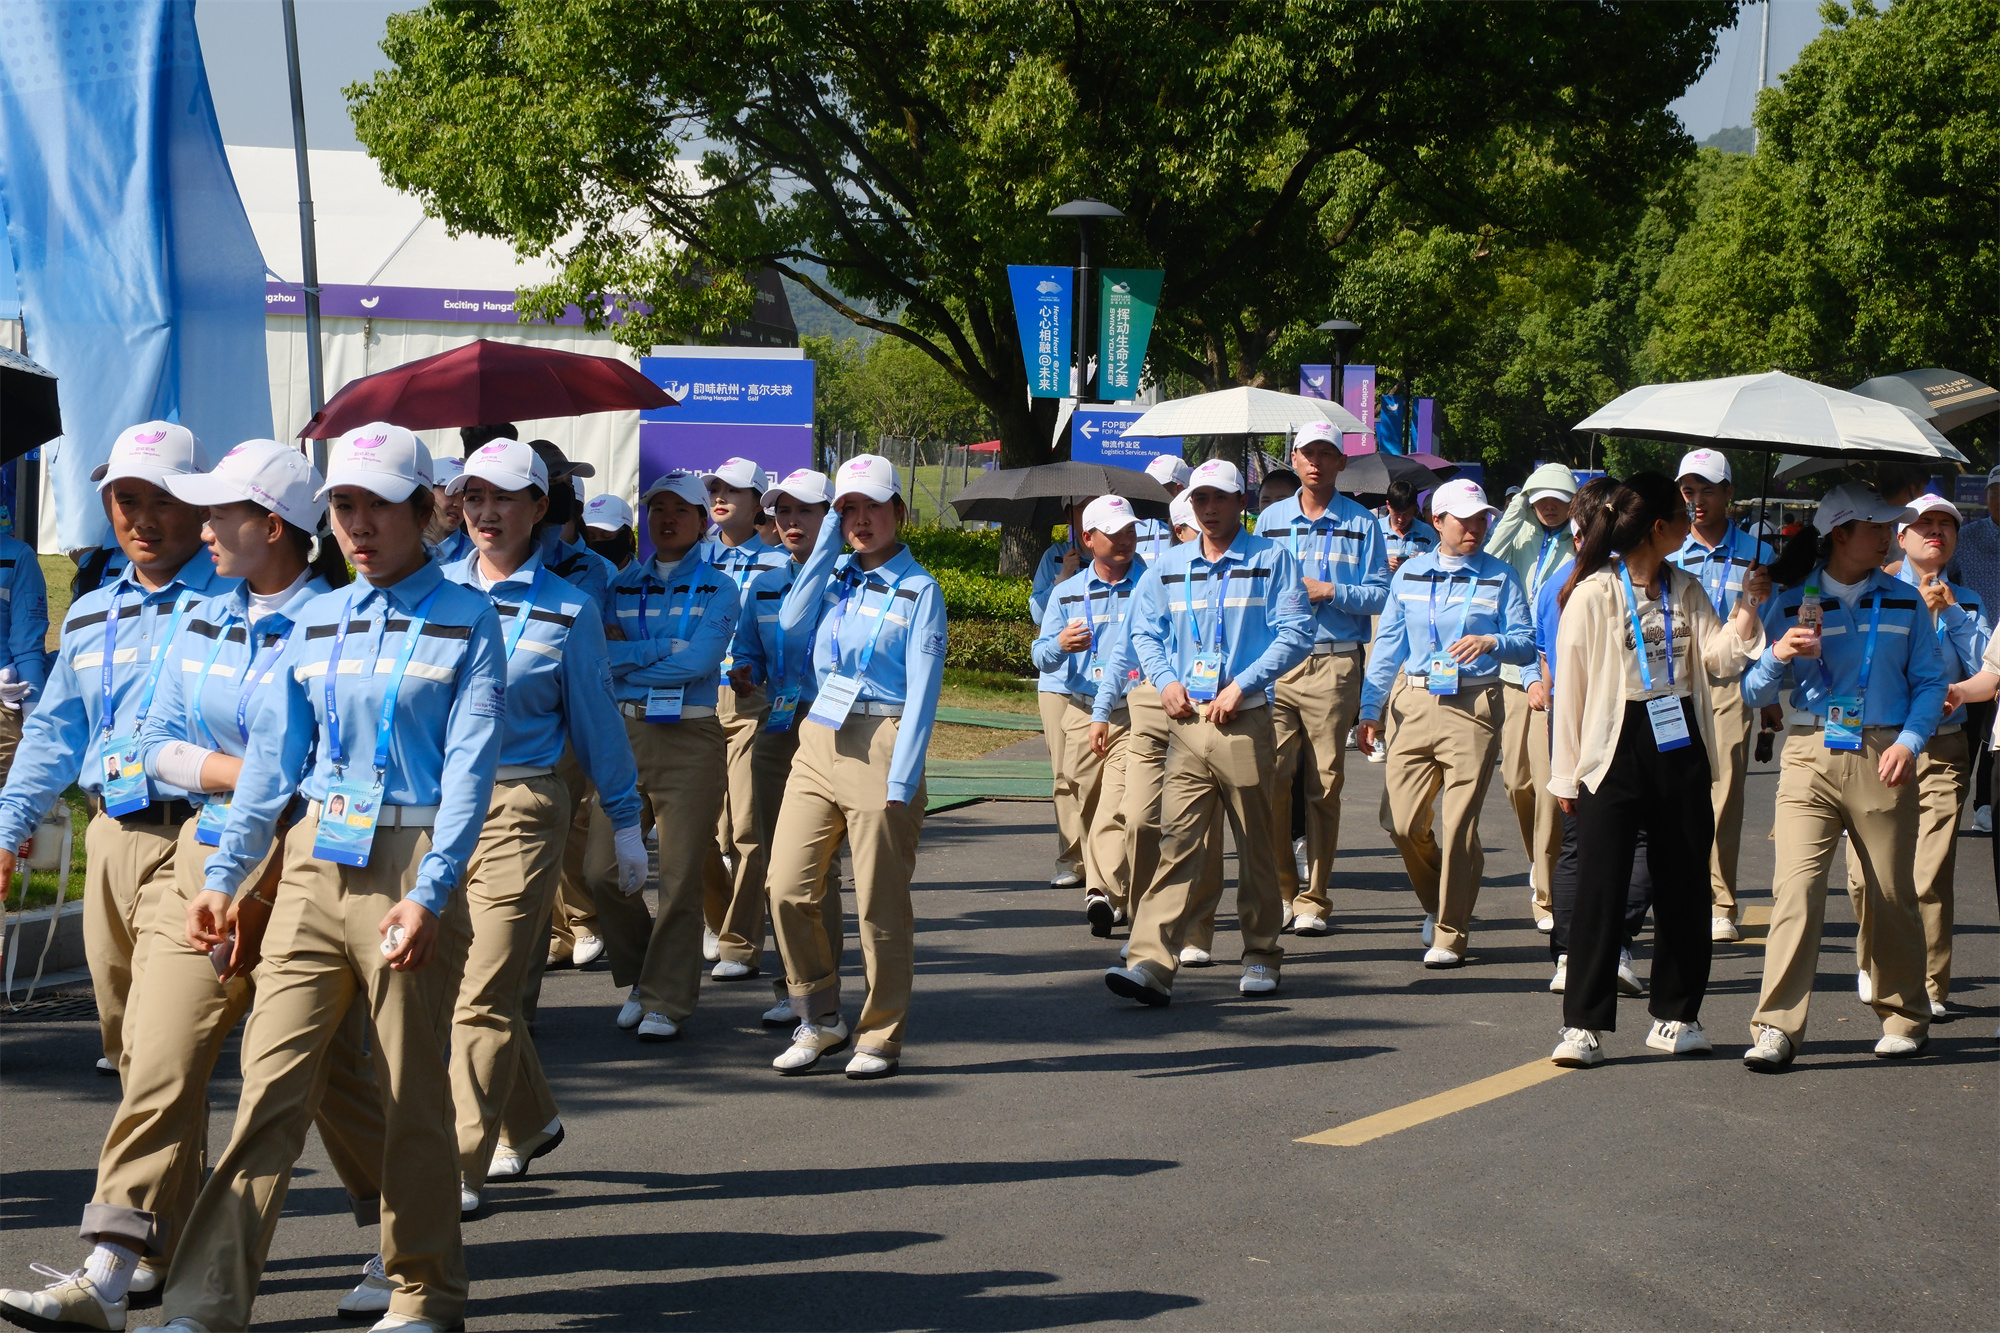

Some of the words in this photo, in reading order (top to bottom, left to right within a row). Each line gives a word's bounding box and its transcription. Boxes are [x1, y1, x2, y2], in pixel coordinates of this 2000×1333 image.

[443, 299, 479, 312] Exciting
[1053, 328, 1060, 336] to
[1039, 305, 1052, 391] 心心相融@未来
[1115, 308, 1130, 388] 挥动生命之美
[693, 394, 713, 402] Exciting
[1361, 380, 1369, 407] Exciting
[1101, 440, 1141, 449] 物流作业区
[141, 798, 147, 806] 2
[352, 815, 366, 827] OC
[357, 856, 364, 865] 2
